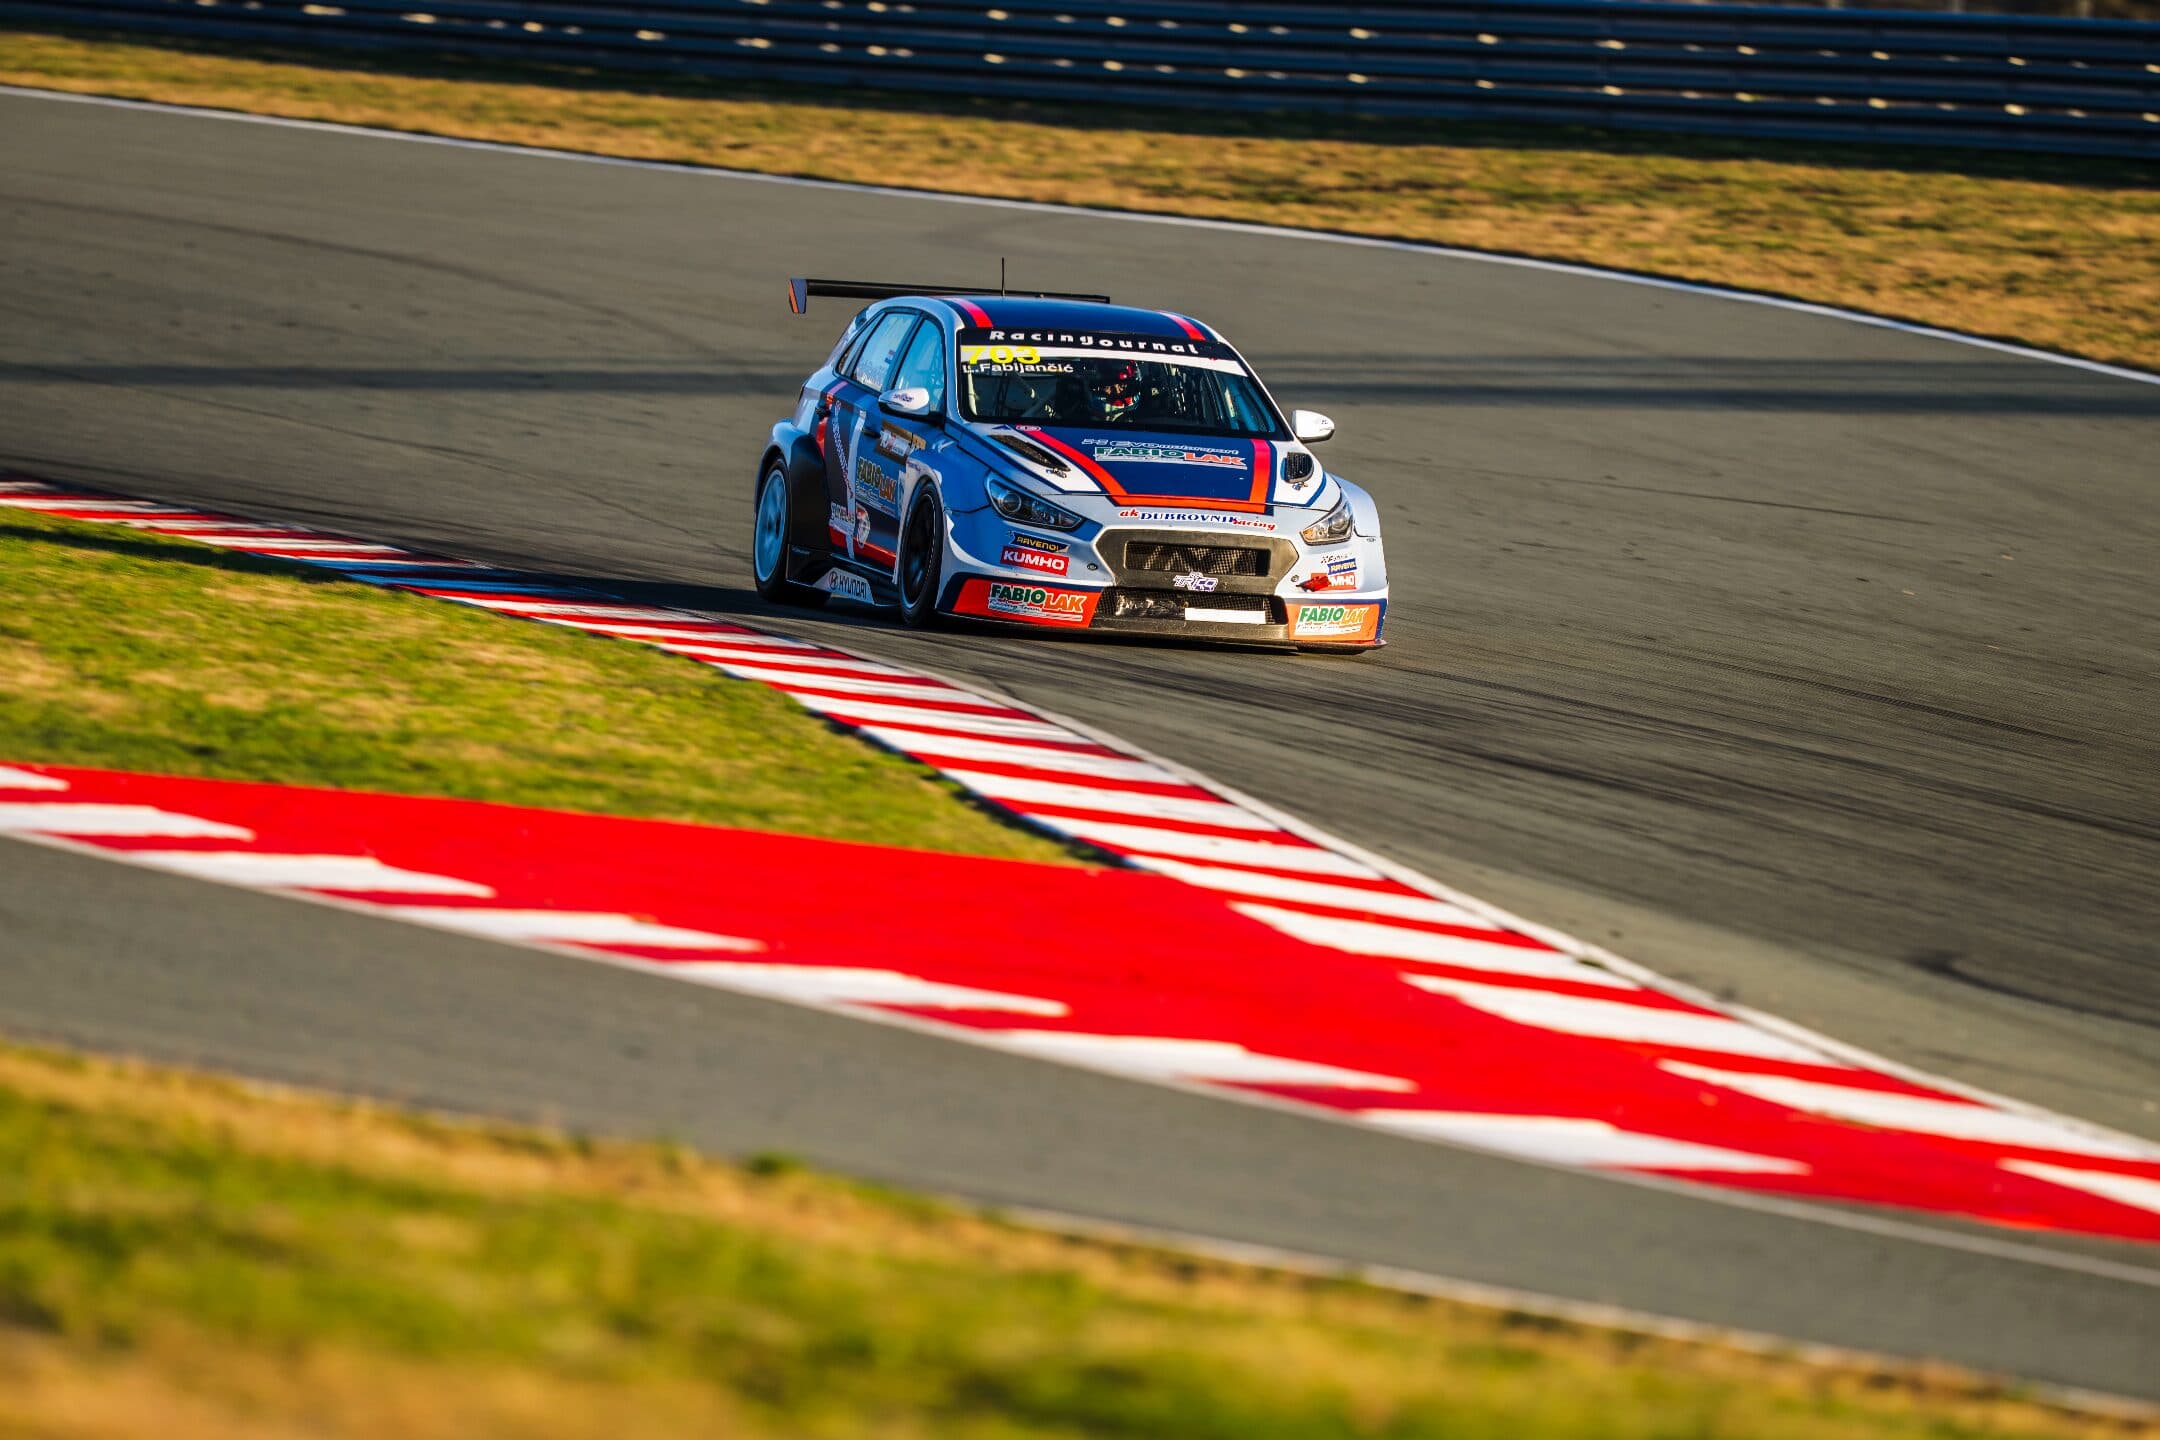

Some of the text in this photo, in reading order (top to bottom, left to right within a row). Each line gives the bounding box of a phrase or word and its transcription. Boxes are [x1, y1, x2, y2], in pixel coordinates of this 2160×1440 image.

[960, 345, 1041, 365] 703
[1095, 447, 1247, 466] FABIOLAK
[1003, 550, 1065, 571] KUMHO
[839, 574, 867, 599] HYUNDAI
[989, 582, 1087, 613] FABIOLAK
[1298, 606, 1369, 626] FABIOLAK
